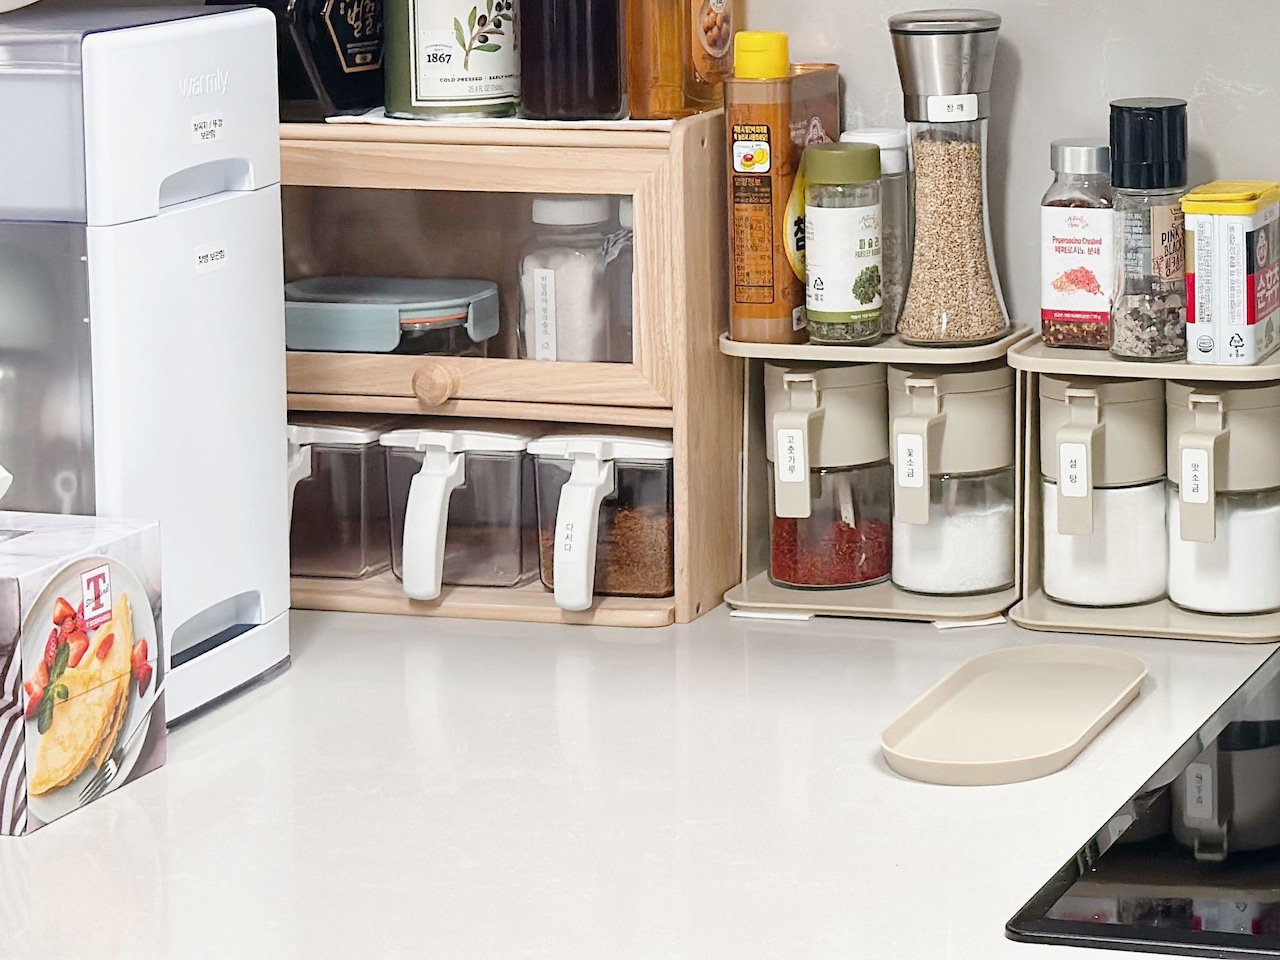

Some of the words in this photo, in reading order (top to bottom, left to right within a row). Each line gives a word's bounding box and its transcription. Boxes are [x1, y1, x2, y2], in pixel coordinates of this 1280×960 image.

[427, 53, 452, 64] 1867
[179, 67, 229, 98] warmly
[1082, 237, 1103, 246] Crushed
[1161, 227, 1180, 246] PINK
[855, 249, 871, 258] PARSLEY
[787, 435, 796, 475] 고춧가루
[563, 523, 574, 552] 다시다
[86, 572, 106, 611] T
